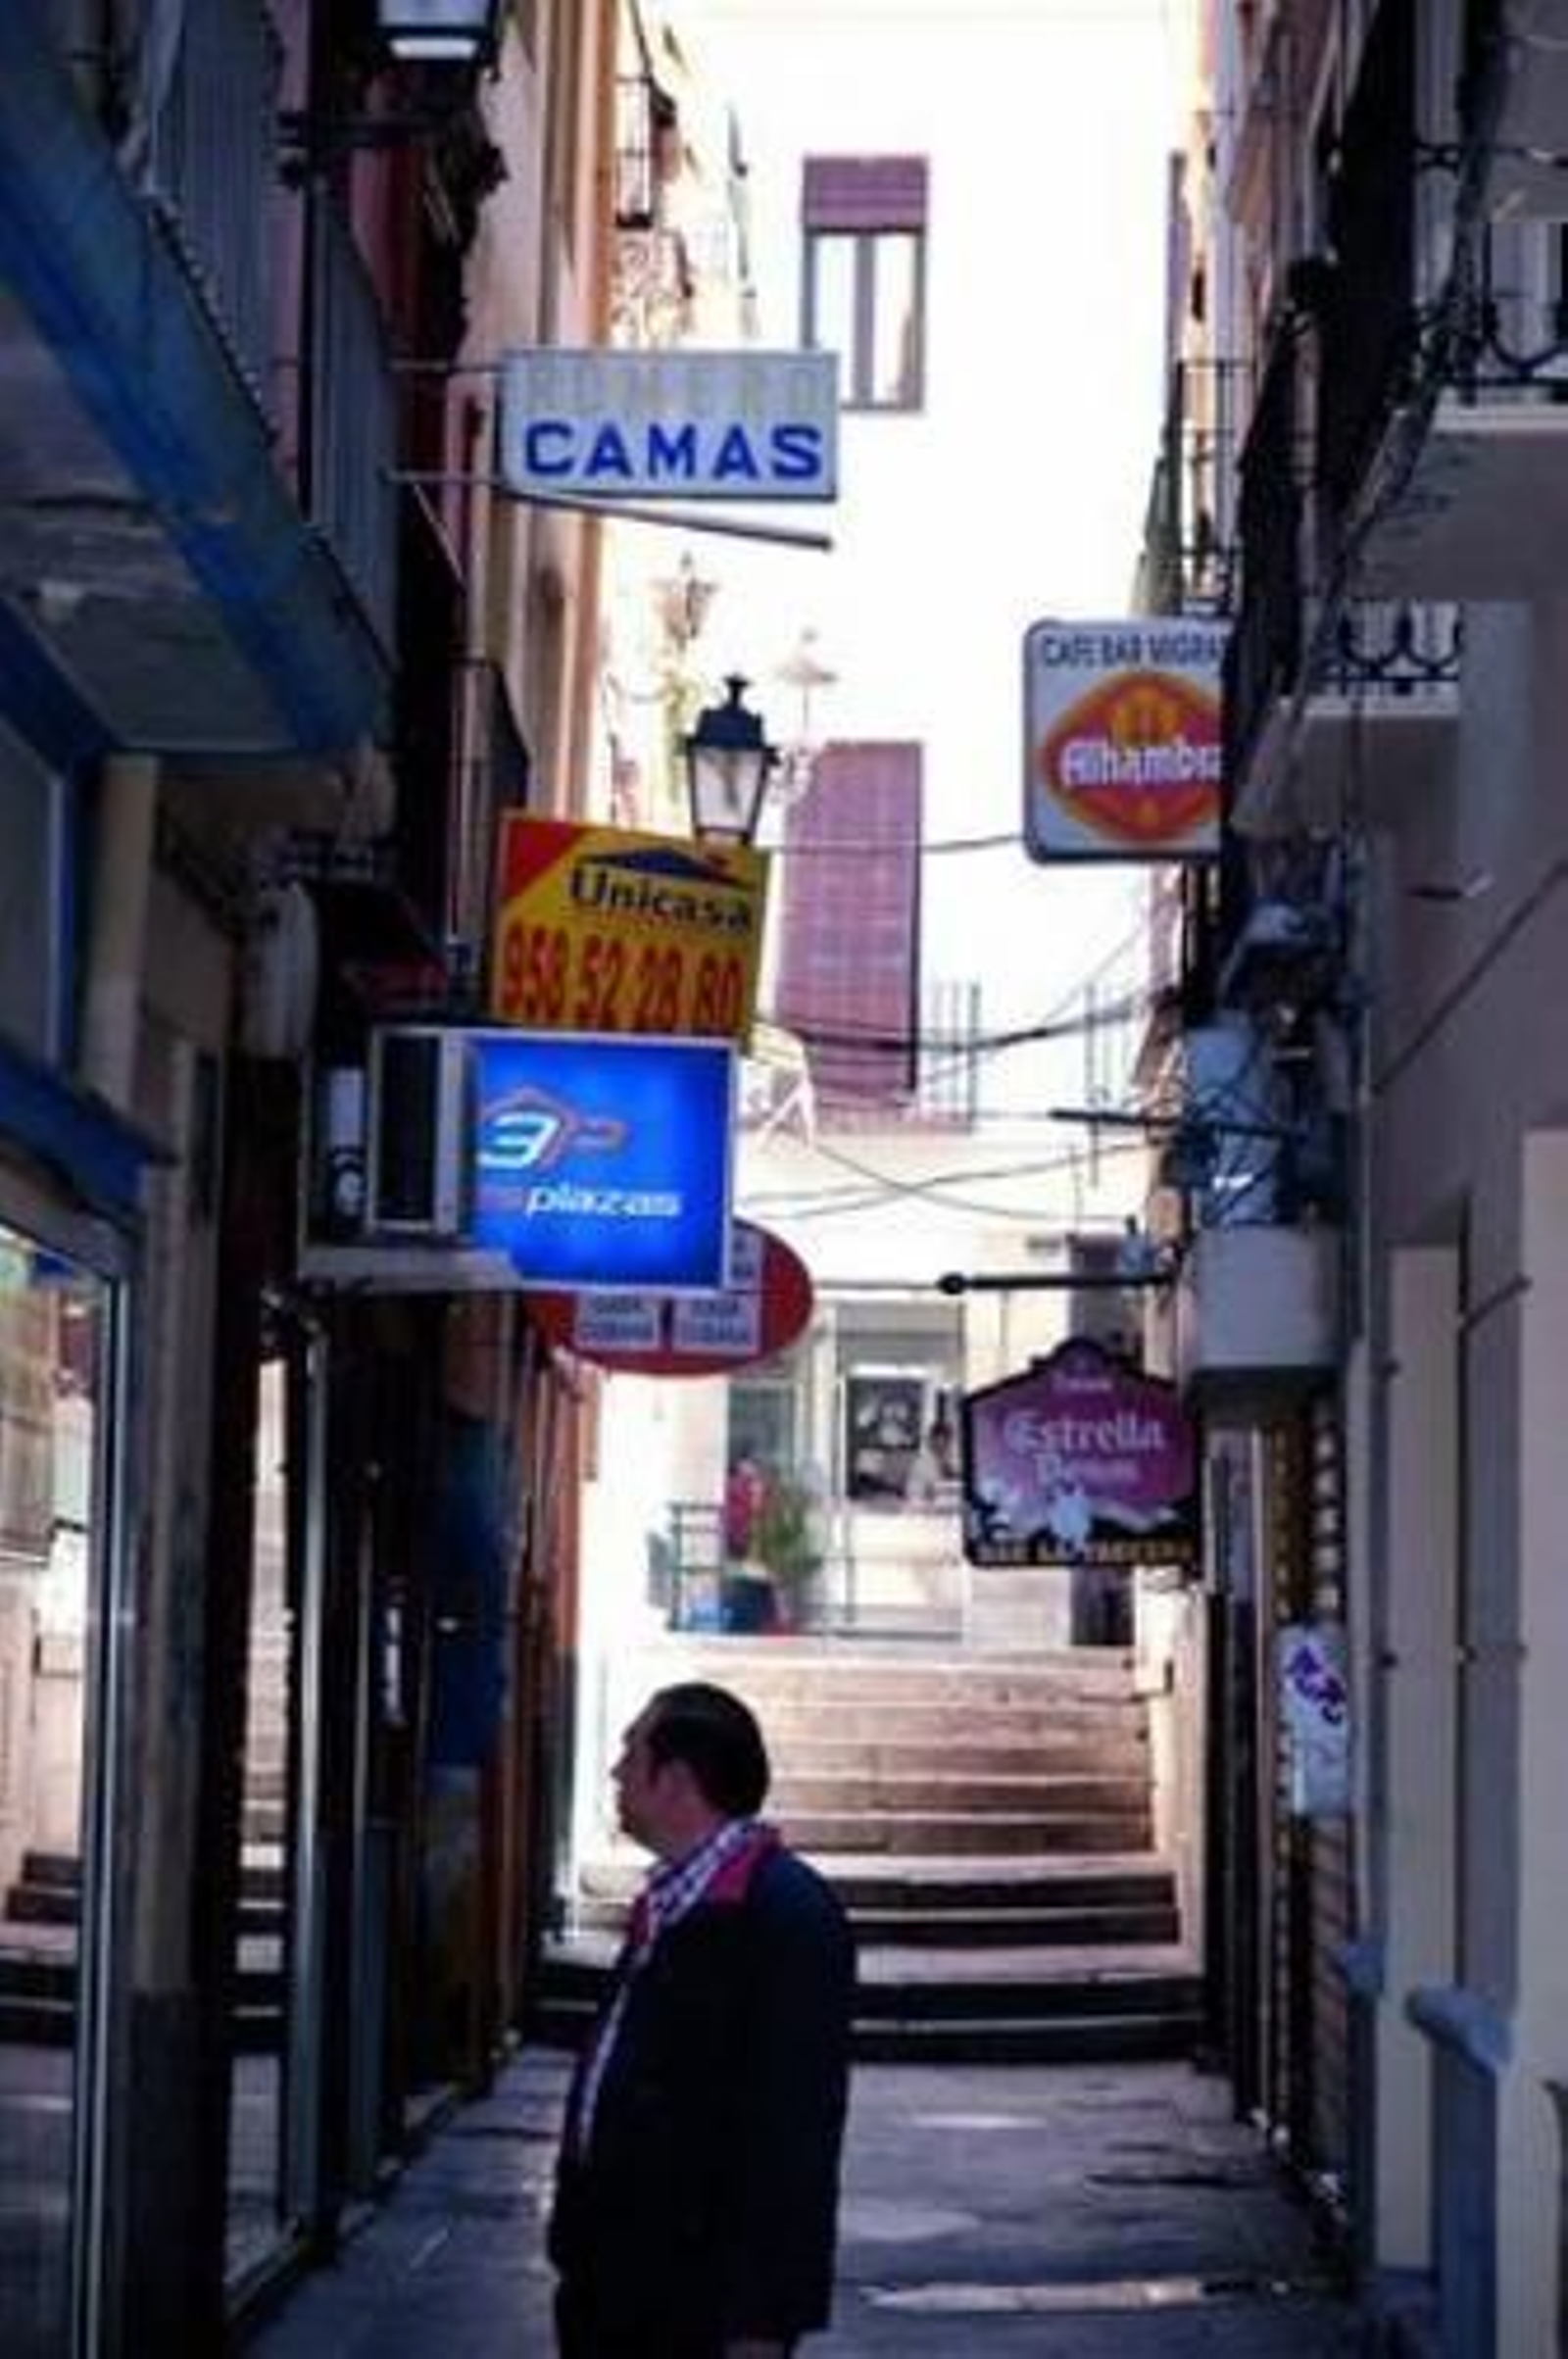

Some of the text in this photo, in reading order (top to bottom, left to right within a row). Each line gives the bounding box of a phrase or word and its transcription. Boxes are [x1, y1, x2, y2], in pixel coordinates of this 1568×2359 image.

[523, 420, 823, 479] CAMAS
[569, 866, 753, 929] Unicasa
[501, 919, 570, 1021] 958
[575, 931, 623, 1028] 52
[634, 943, 683, 1032] 28
[523, 1181, 682, 1219] plazas
[1003, 1409, 1164, 1455] Estrella
